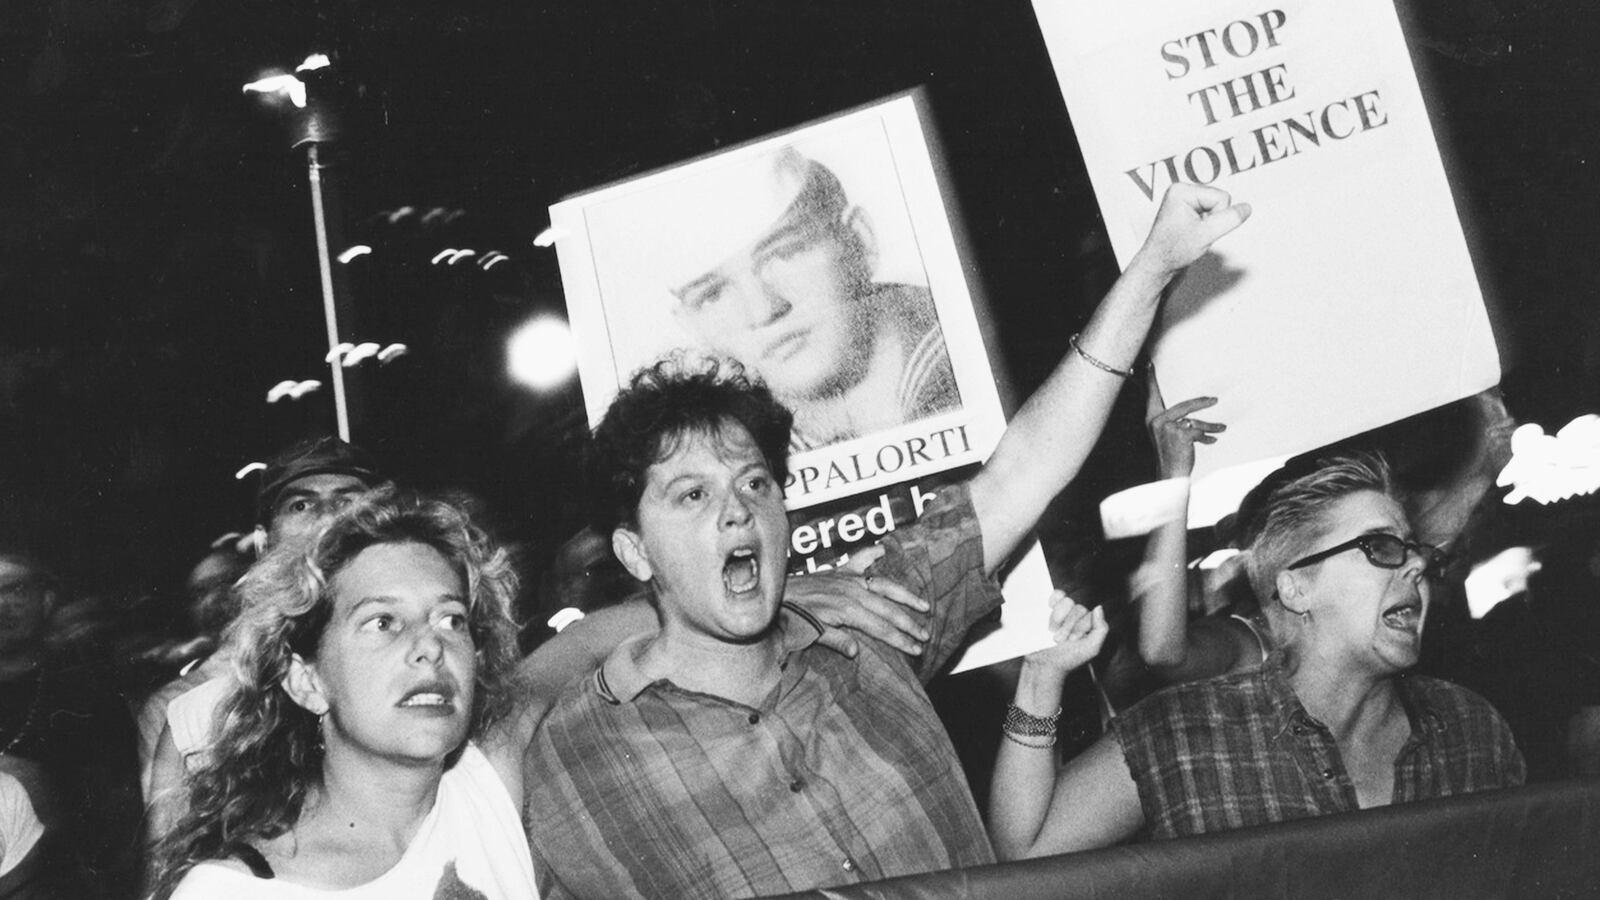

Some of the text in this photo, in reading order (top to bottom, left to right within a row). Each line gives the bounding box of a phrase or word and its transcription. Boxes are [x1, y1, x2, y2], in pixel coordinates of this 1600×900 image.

[1160, 8, 1287, 80] STOP
[1187, 63, 1297, 126] THE
[1124, 90, 1389, 203] VIOLENCE
[787, 494, 896, 558] ered
